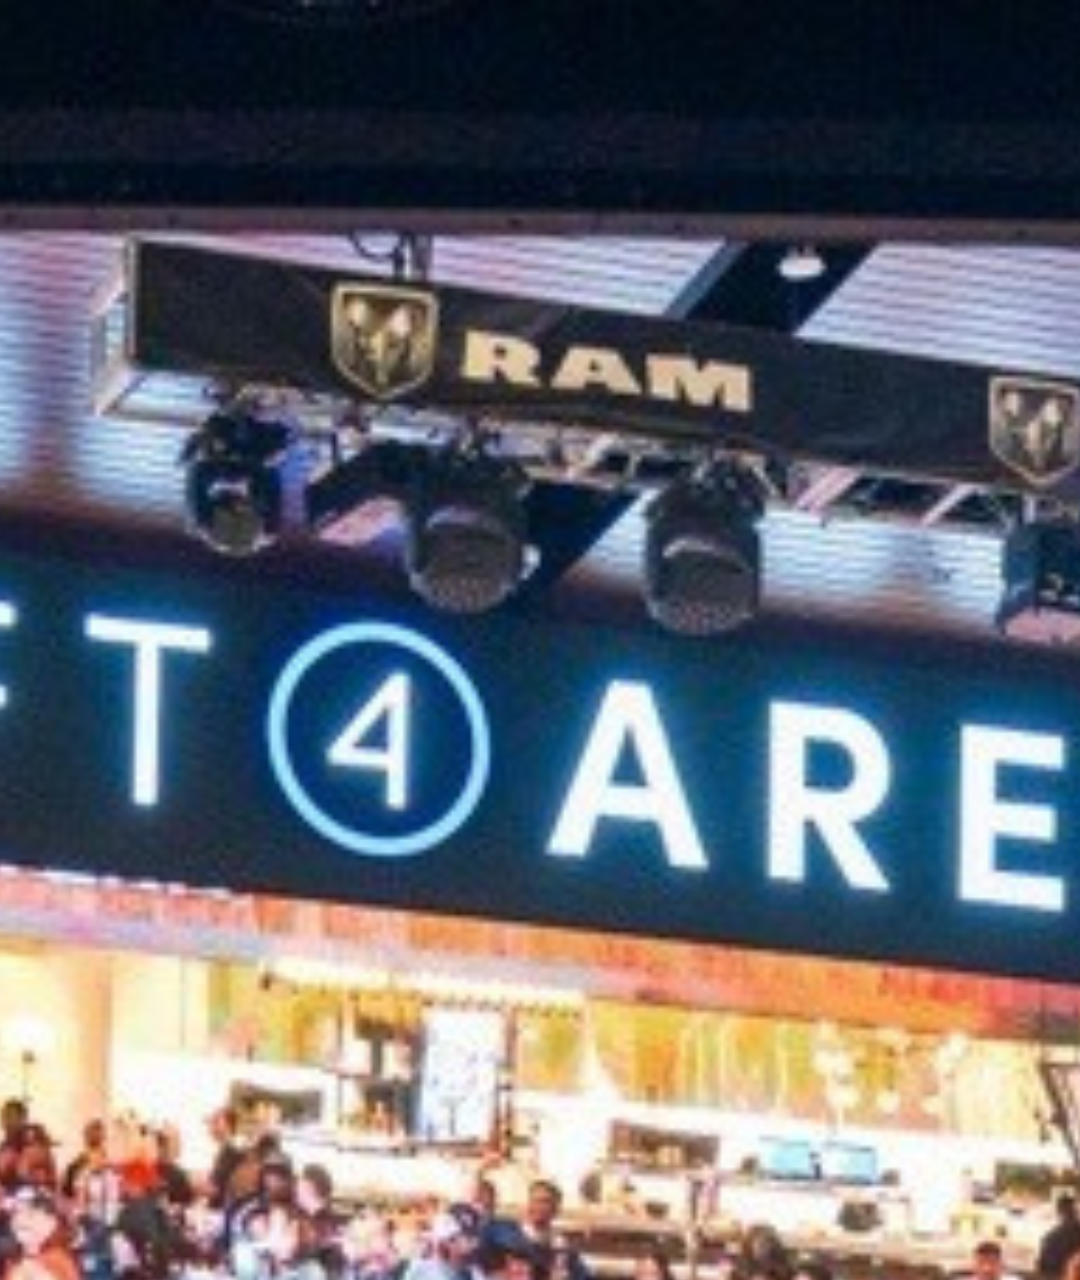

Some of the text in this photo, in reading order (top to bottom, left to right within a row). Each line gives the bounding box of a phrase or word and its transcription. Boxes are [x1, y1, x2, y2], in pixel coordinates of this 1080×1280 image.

[461, 328, 753, 413] RAM
[325, 670, 413, 813] 4
[545, 679, 1067, 914] ARE
